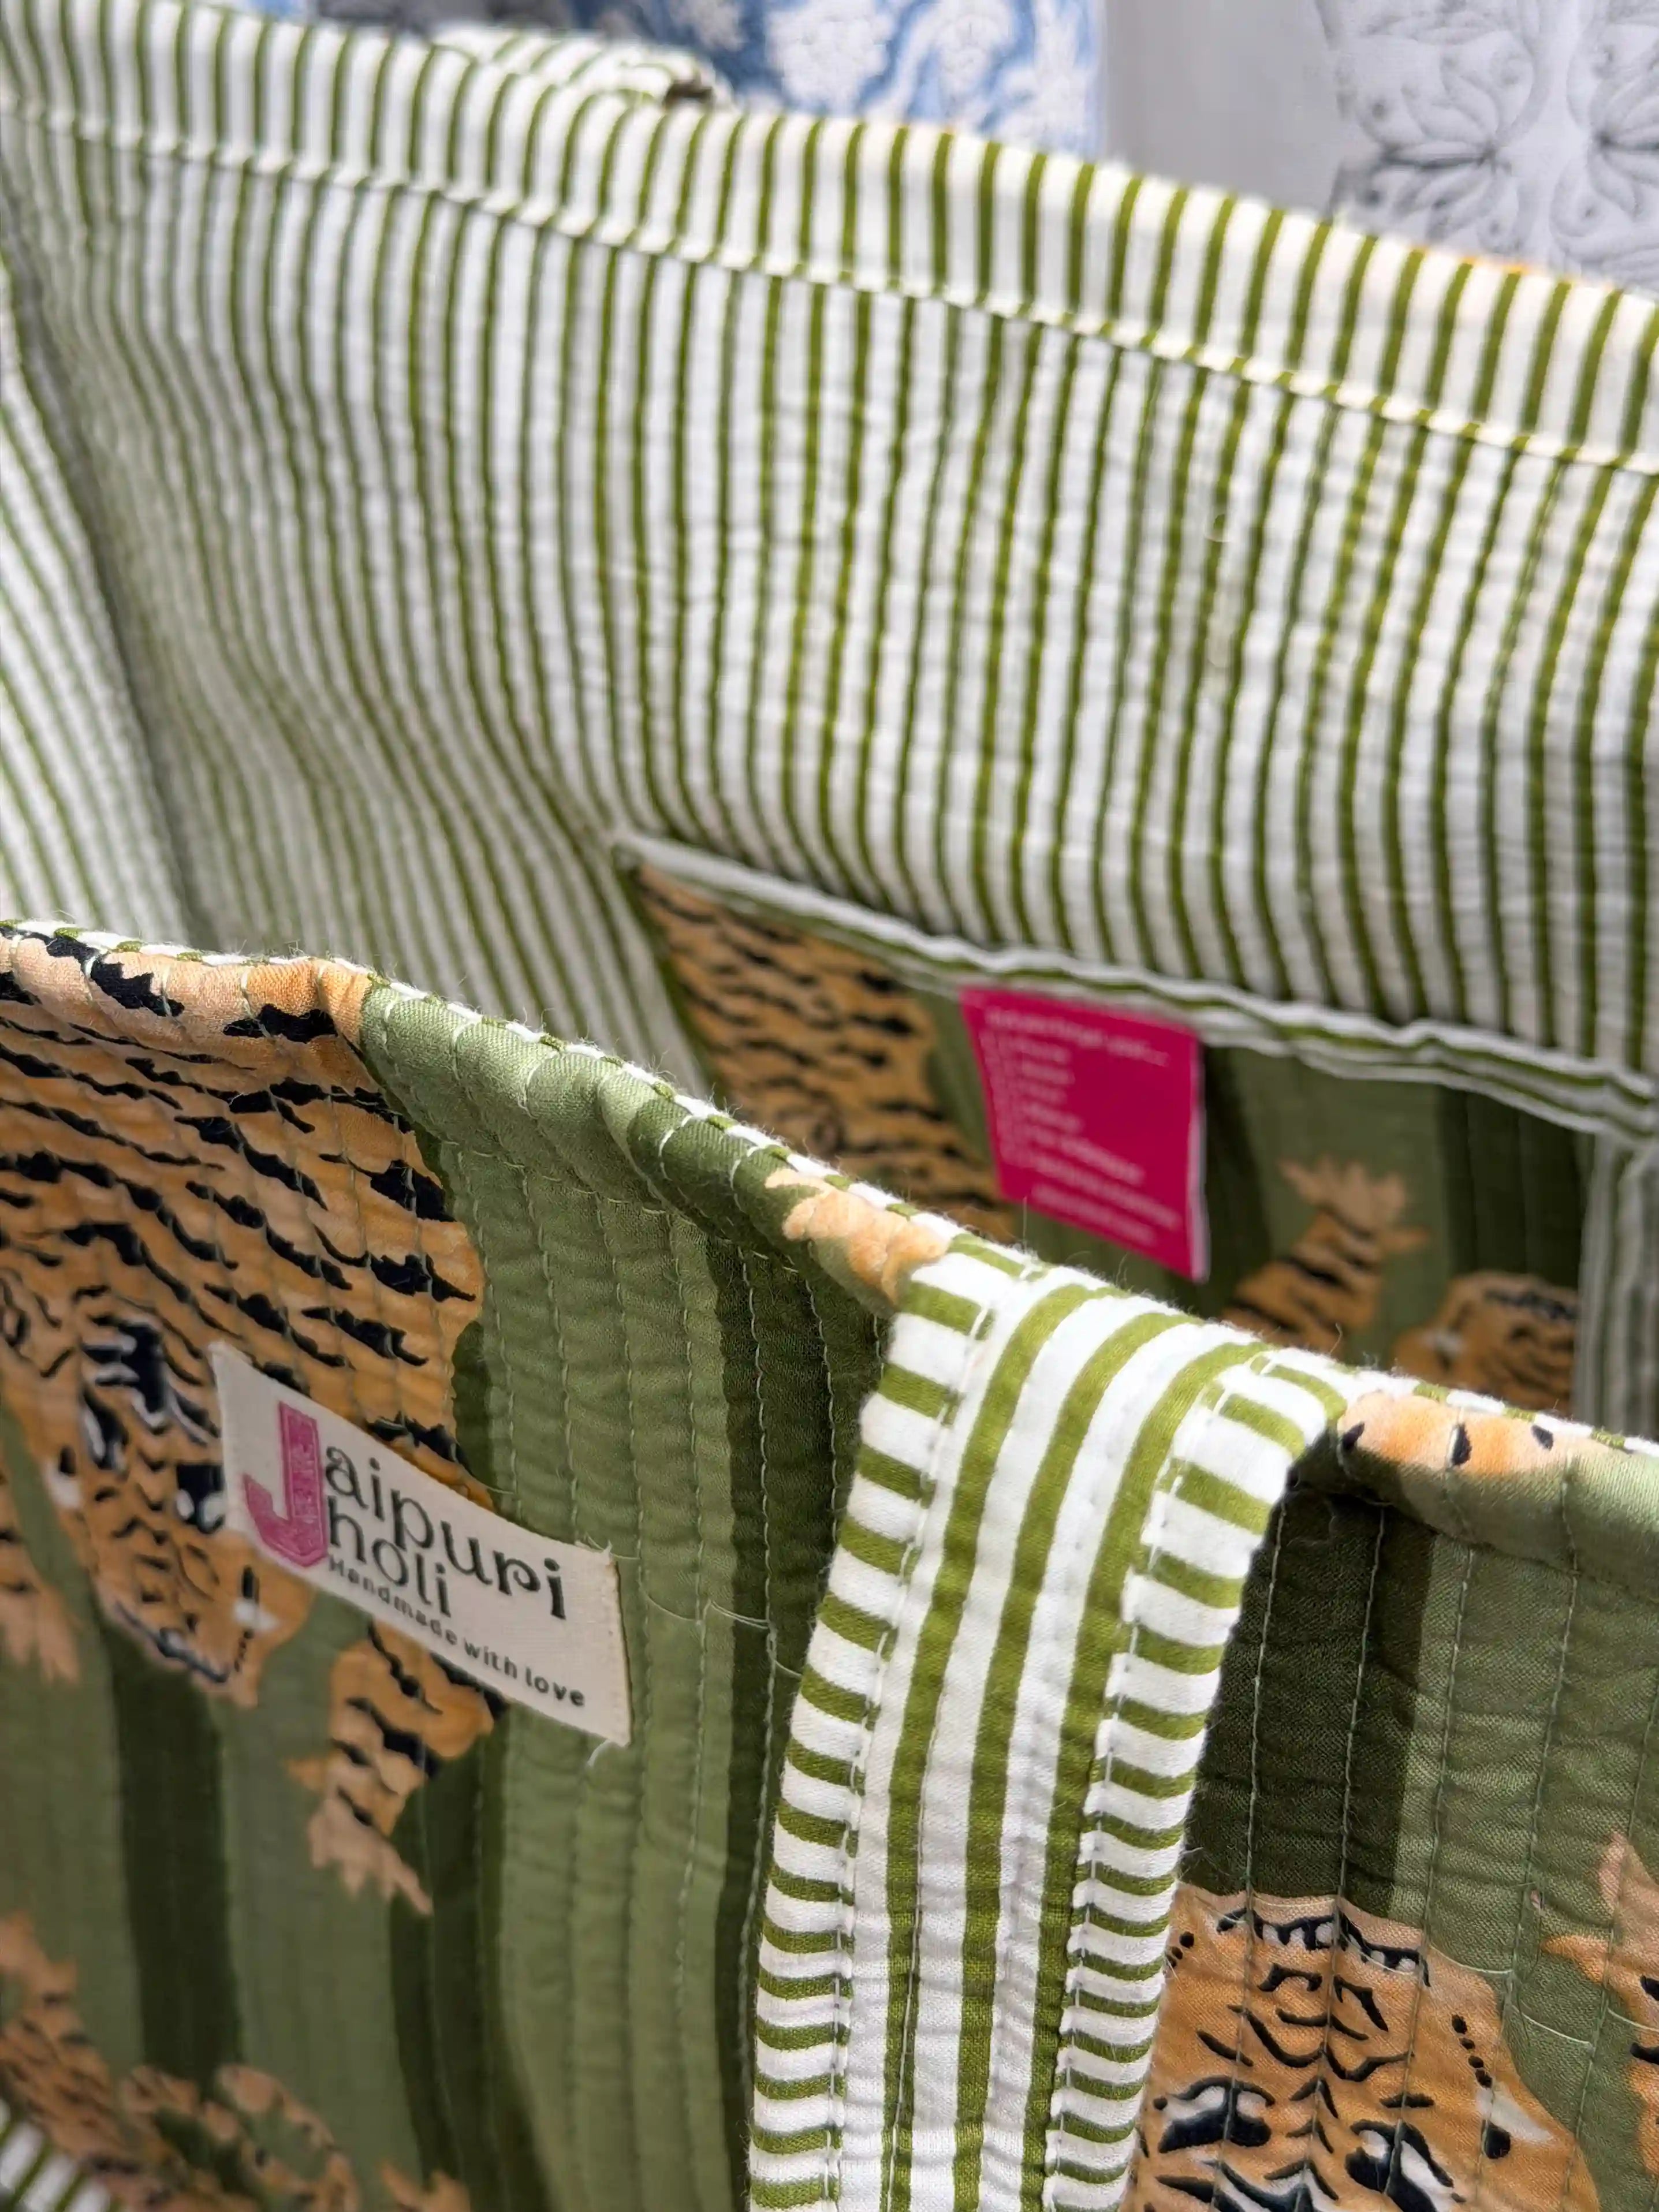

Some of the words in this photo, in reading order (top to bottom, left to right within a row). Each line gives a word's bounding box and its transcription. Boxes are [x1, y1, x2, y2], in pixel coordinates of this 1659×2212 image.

[243, 1401, 566, 1619] Jaipuri
[329, 1554, 458, 1645] Handmade
[464, 1636, 517, 1679] with
[525, 1667, 586, 1707] love
